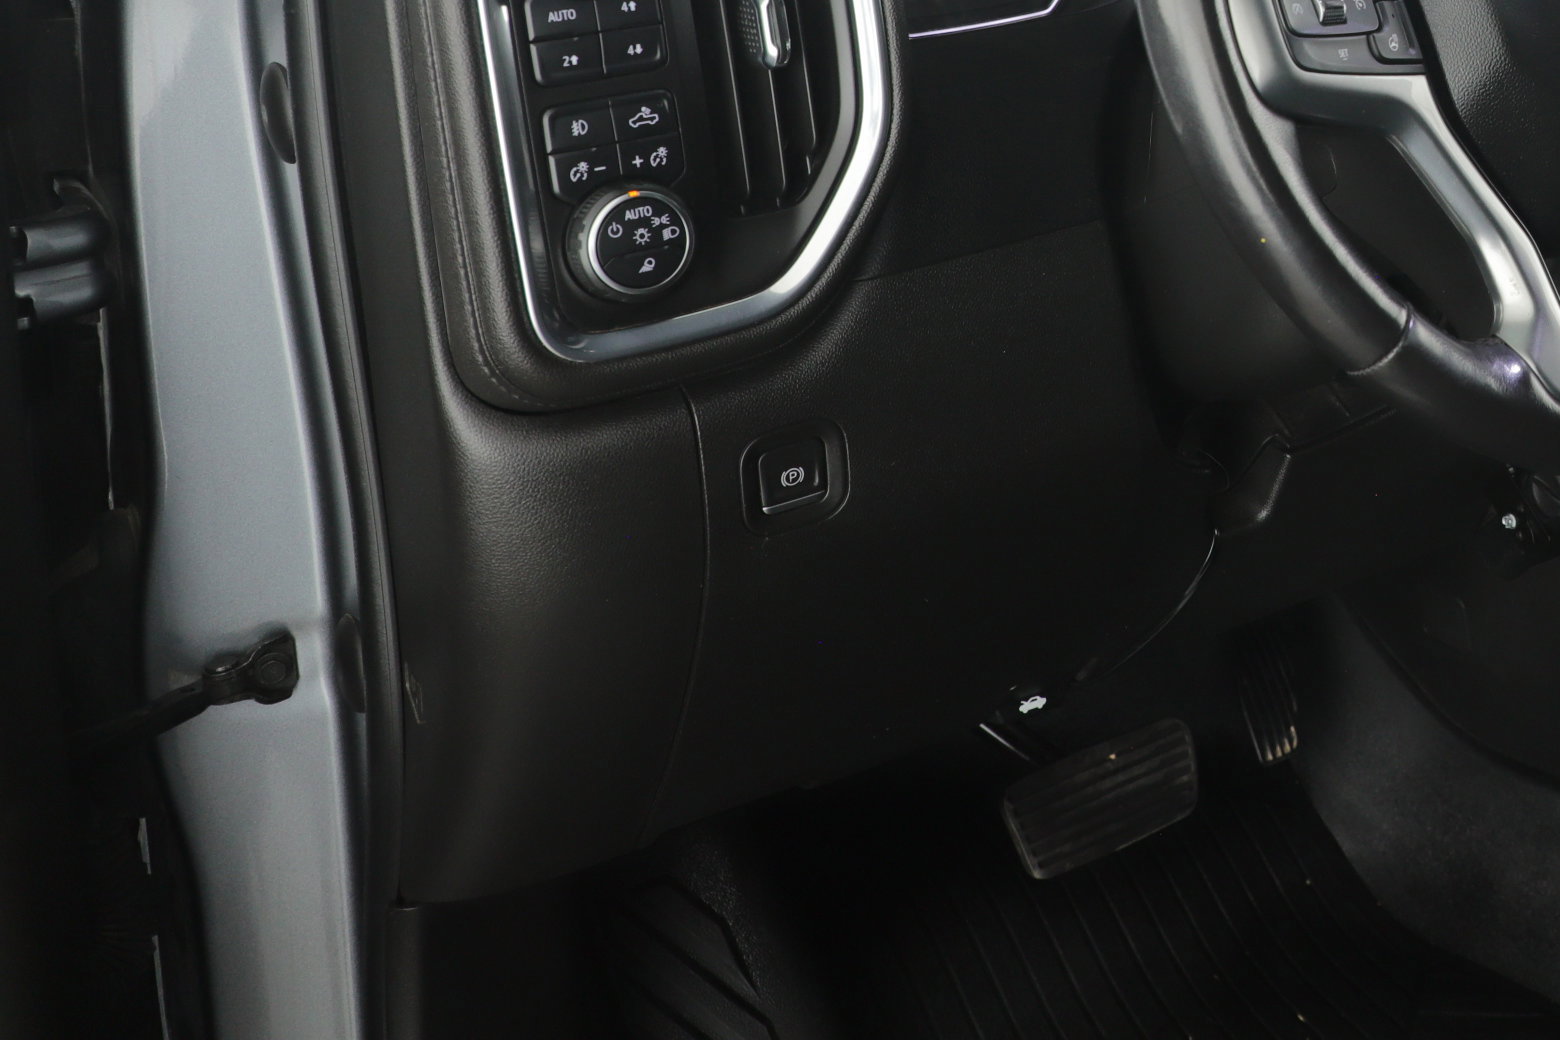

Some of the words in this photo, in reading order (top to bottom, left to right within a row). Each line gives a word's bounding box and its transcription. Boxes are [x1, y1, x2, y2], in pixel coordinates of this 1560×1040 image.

[621, 1, 629, 13] 4
[547, 9, 577, 23] AUTO
[627, 44, 635, 56] 4
[562, 55, 570, 67] 2
[624, 206, 653, 221] AUTO
